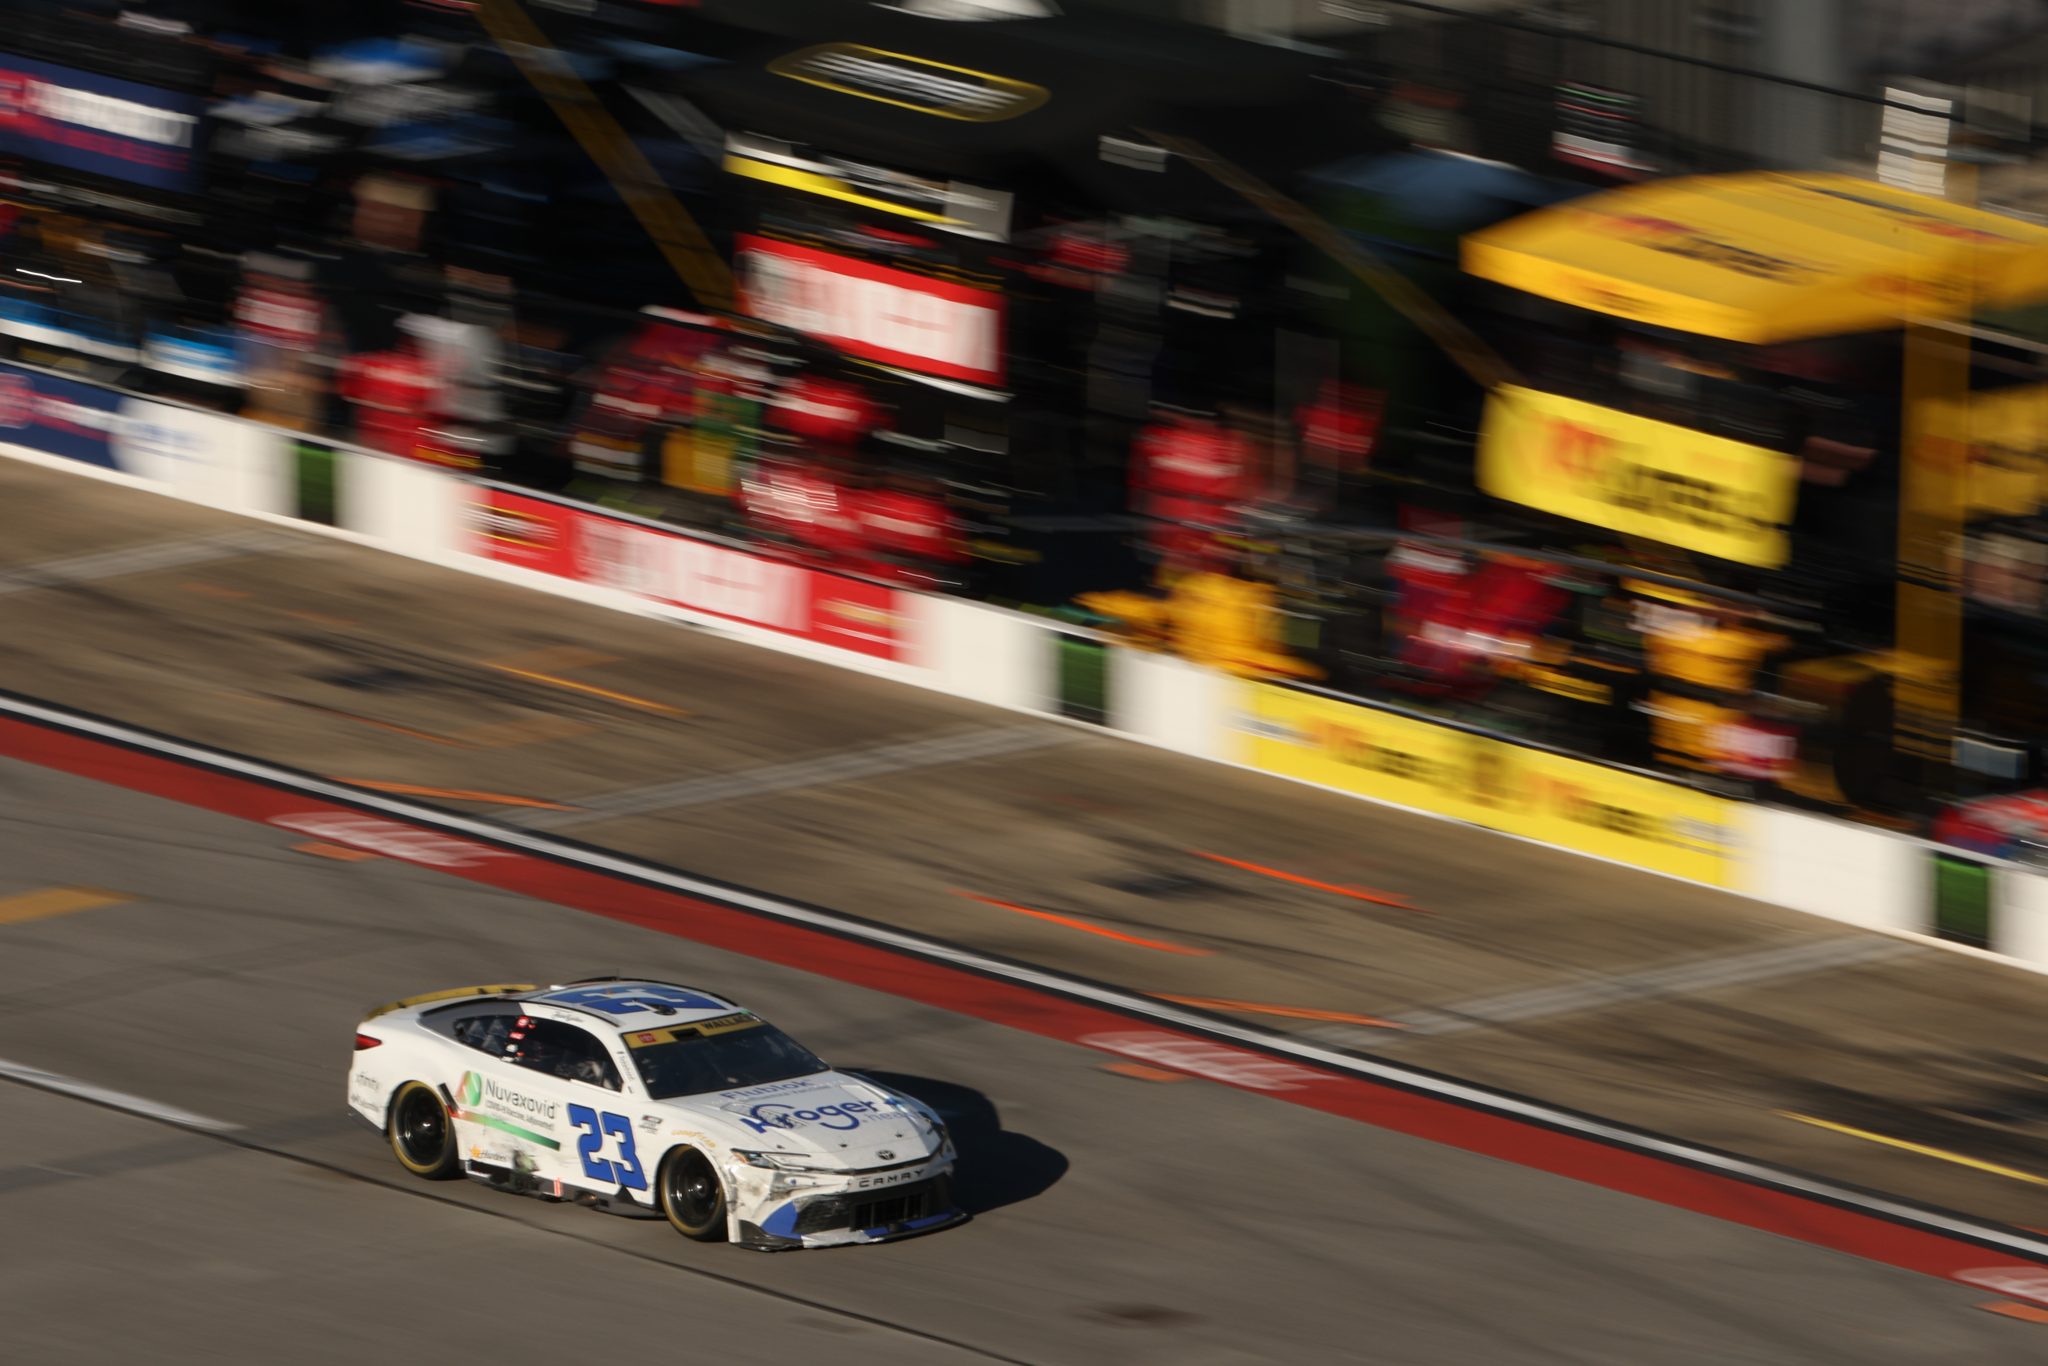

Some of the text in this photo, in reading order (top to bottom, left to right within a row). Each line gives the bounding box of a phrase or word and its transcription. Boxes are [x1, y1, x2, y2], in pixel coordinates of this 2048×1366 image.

[484, 1078, 557, 1119] Nuvaxovid
[719, 1081, 812, 1099] Flublok
[739, 1102, 878, 1133] Kroger
[567, 1102, 648, 1192] 23
[859, 1169, 925, 1188] CAMRY
